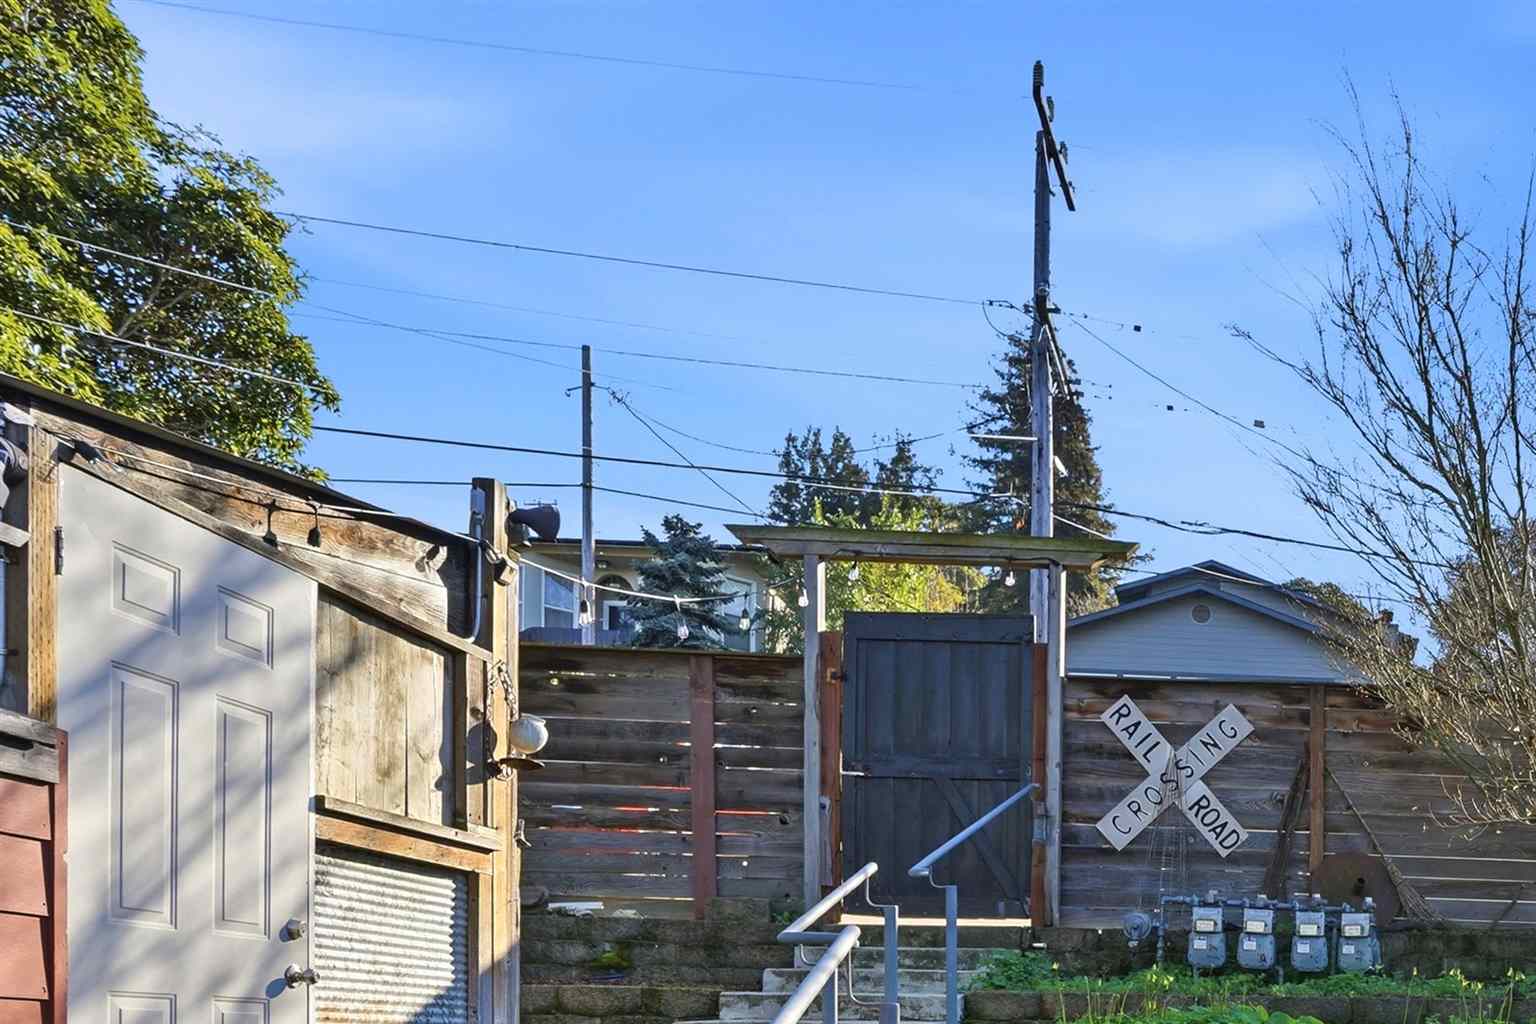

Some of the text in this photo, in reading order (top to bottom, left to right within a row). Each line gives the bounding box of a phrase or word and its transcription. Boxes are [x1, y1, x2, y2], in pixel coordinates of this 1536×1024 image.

[1109, 703, 1240, 850] RAIL ROAD
[1112, 719, 1238, 835] CROSSING
